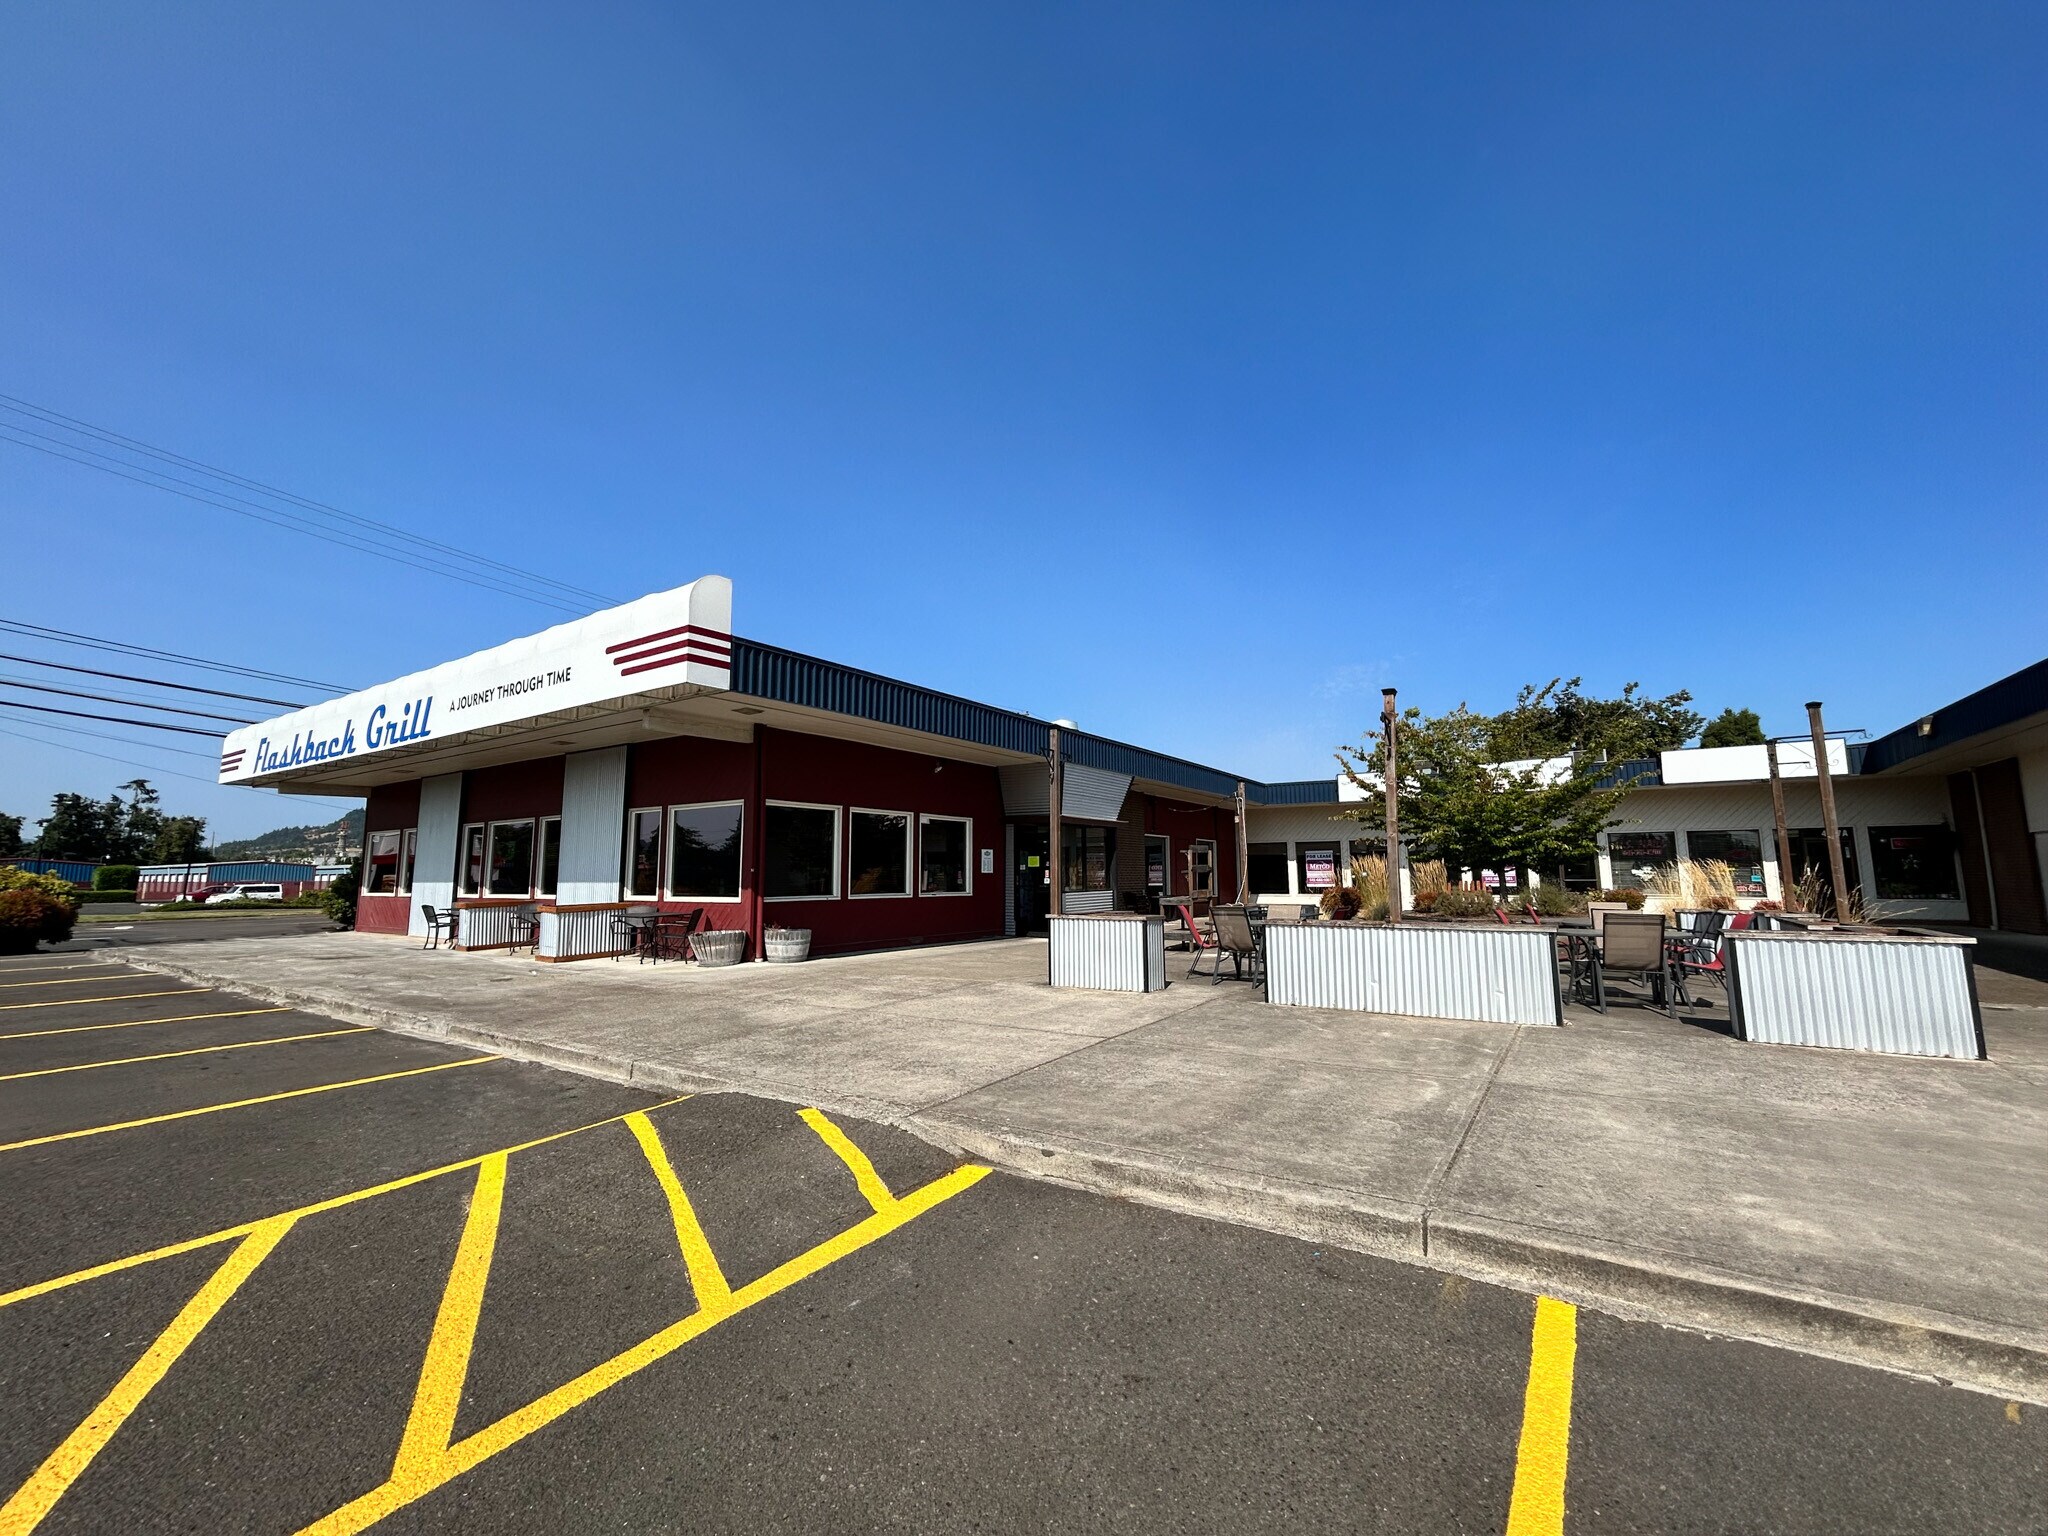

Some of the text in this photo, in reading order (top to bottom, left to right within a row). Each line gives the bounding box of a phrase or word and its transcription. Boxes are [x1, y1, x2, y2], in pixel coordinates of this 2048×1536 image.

[449, 666, 572, 713] A JOURNEY THROUGH TIME
[253, 695, 434, 774] Flashback Grill
